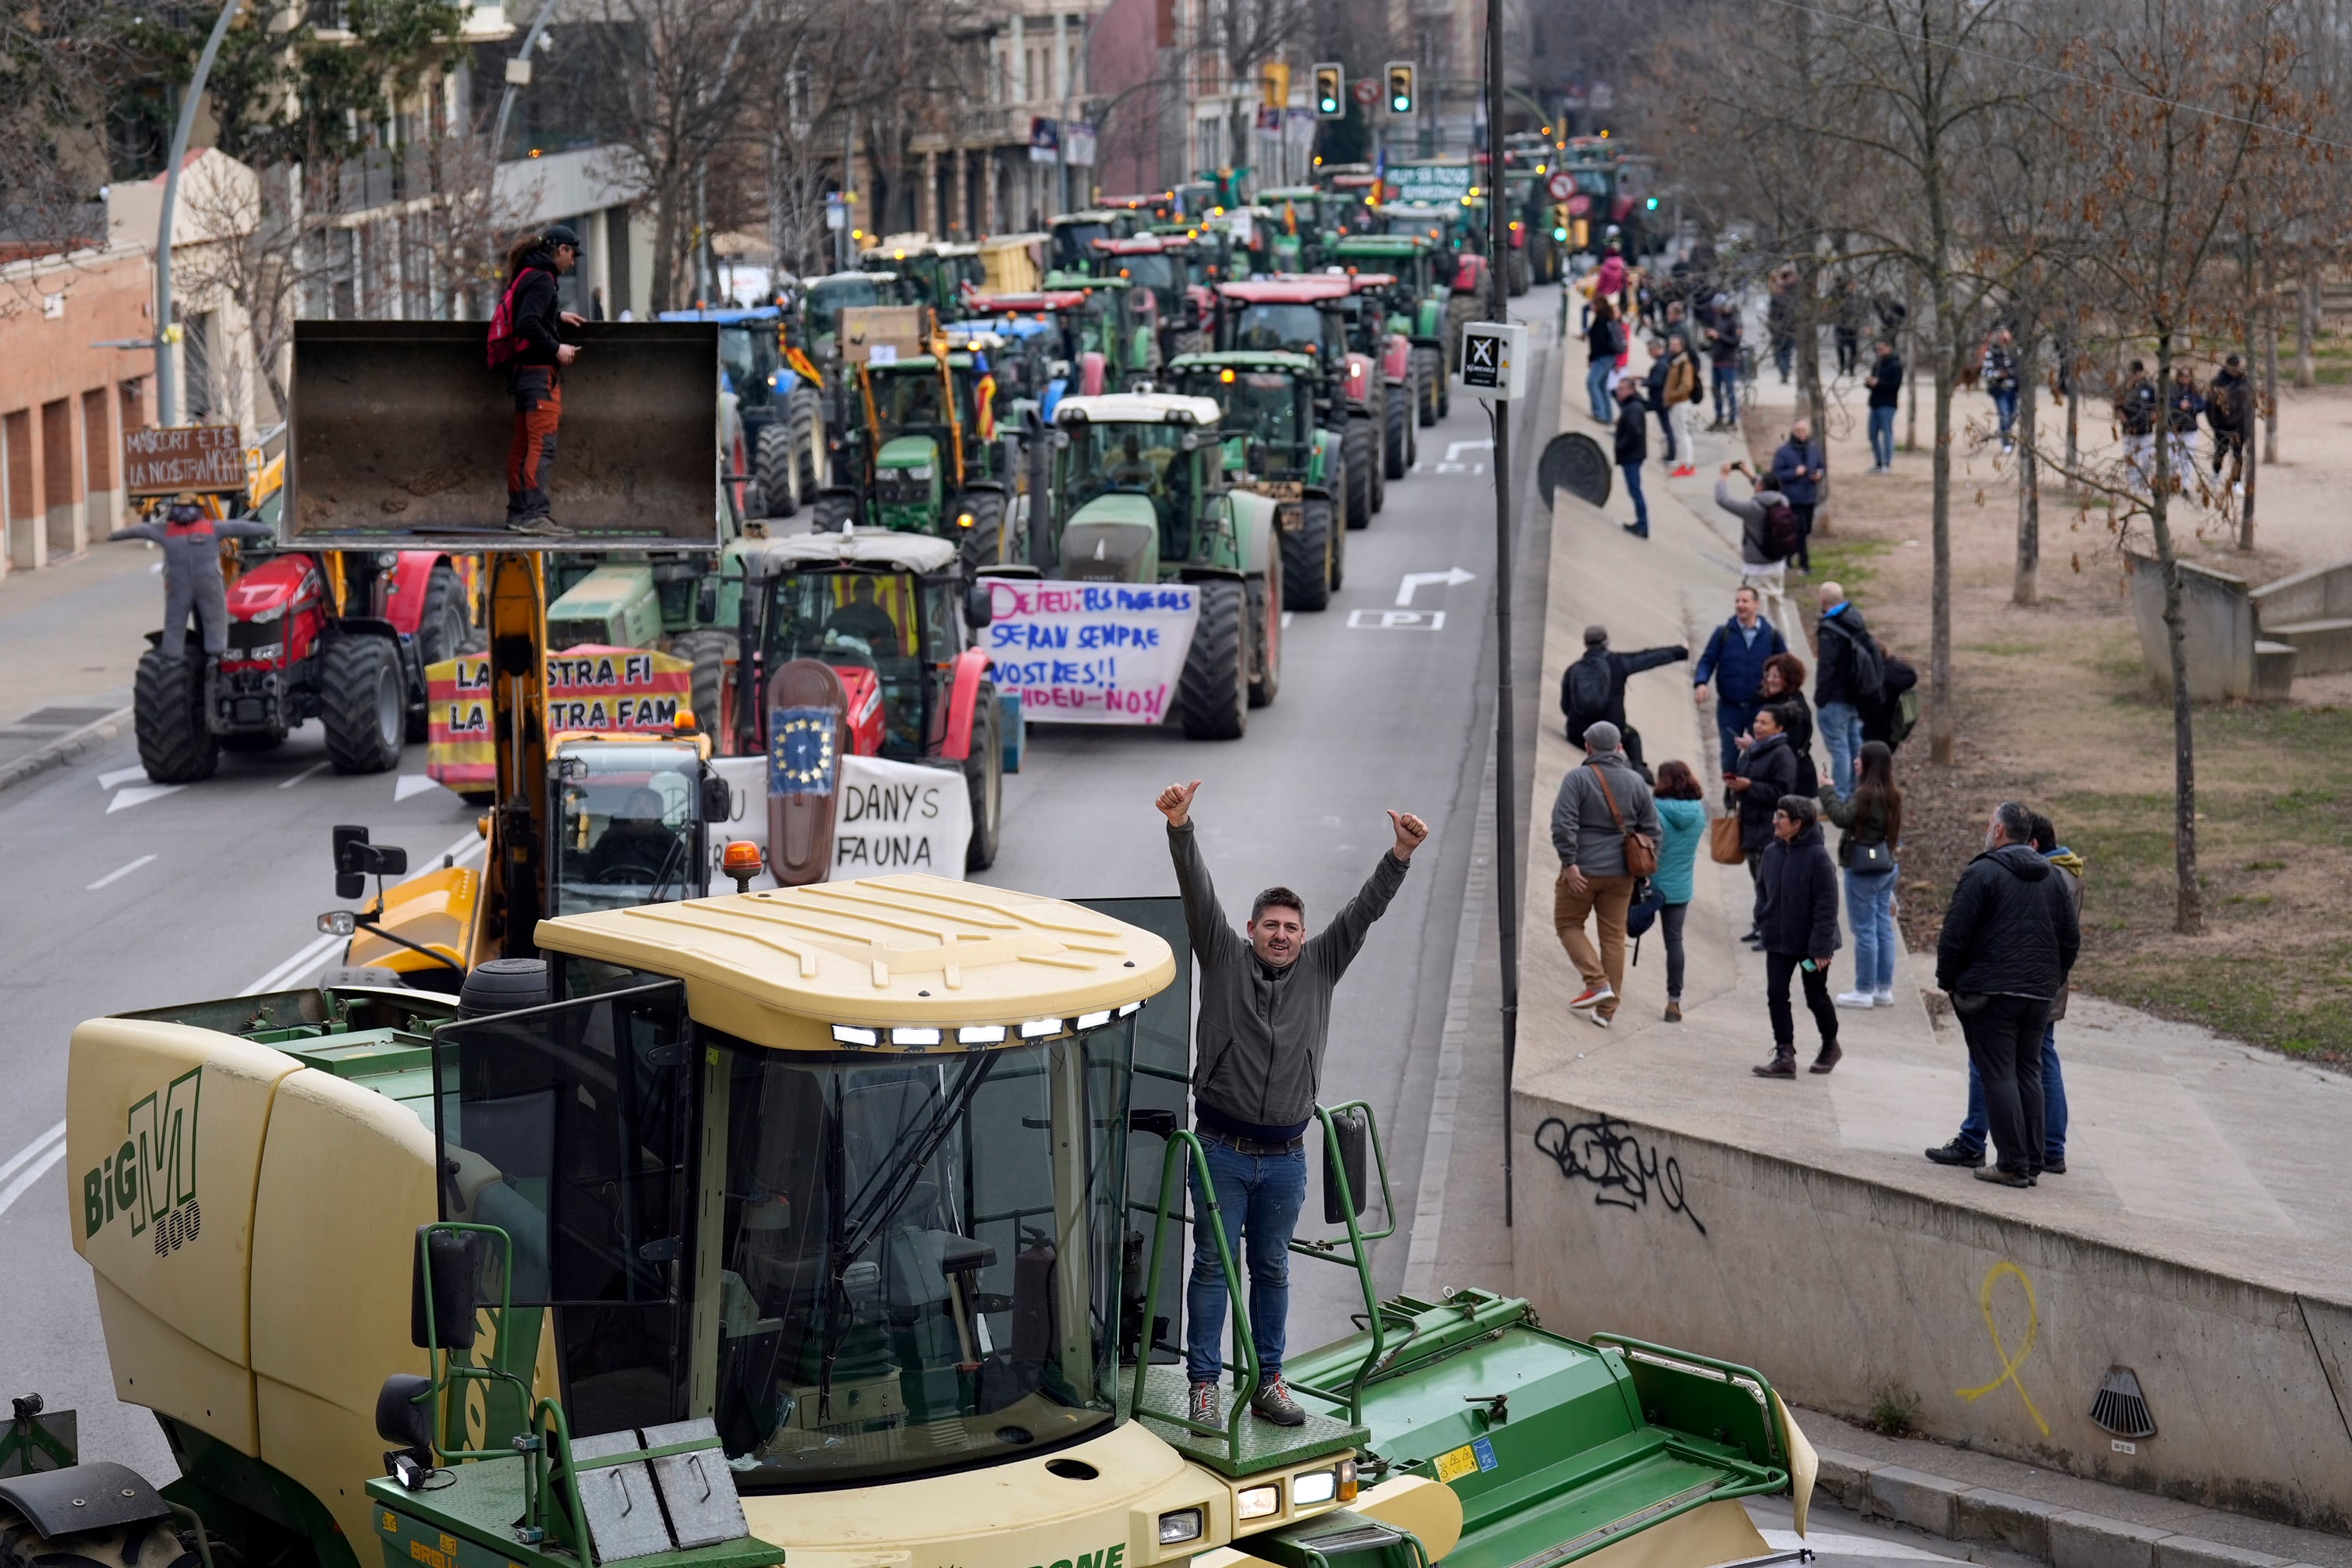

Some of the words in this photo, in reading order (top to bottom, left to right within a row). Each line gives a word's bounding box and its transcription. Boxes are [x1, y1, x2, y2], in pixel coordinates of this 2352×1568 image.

[129, 462, 147, 487] LA
[448, 703, 487, 731] LA
[843, 783, 940, 823] DANYS
[836, 835, 933, 868] FAUNA
[155, 1199, 200, 1258] 400
